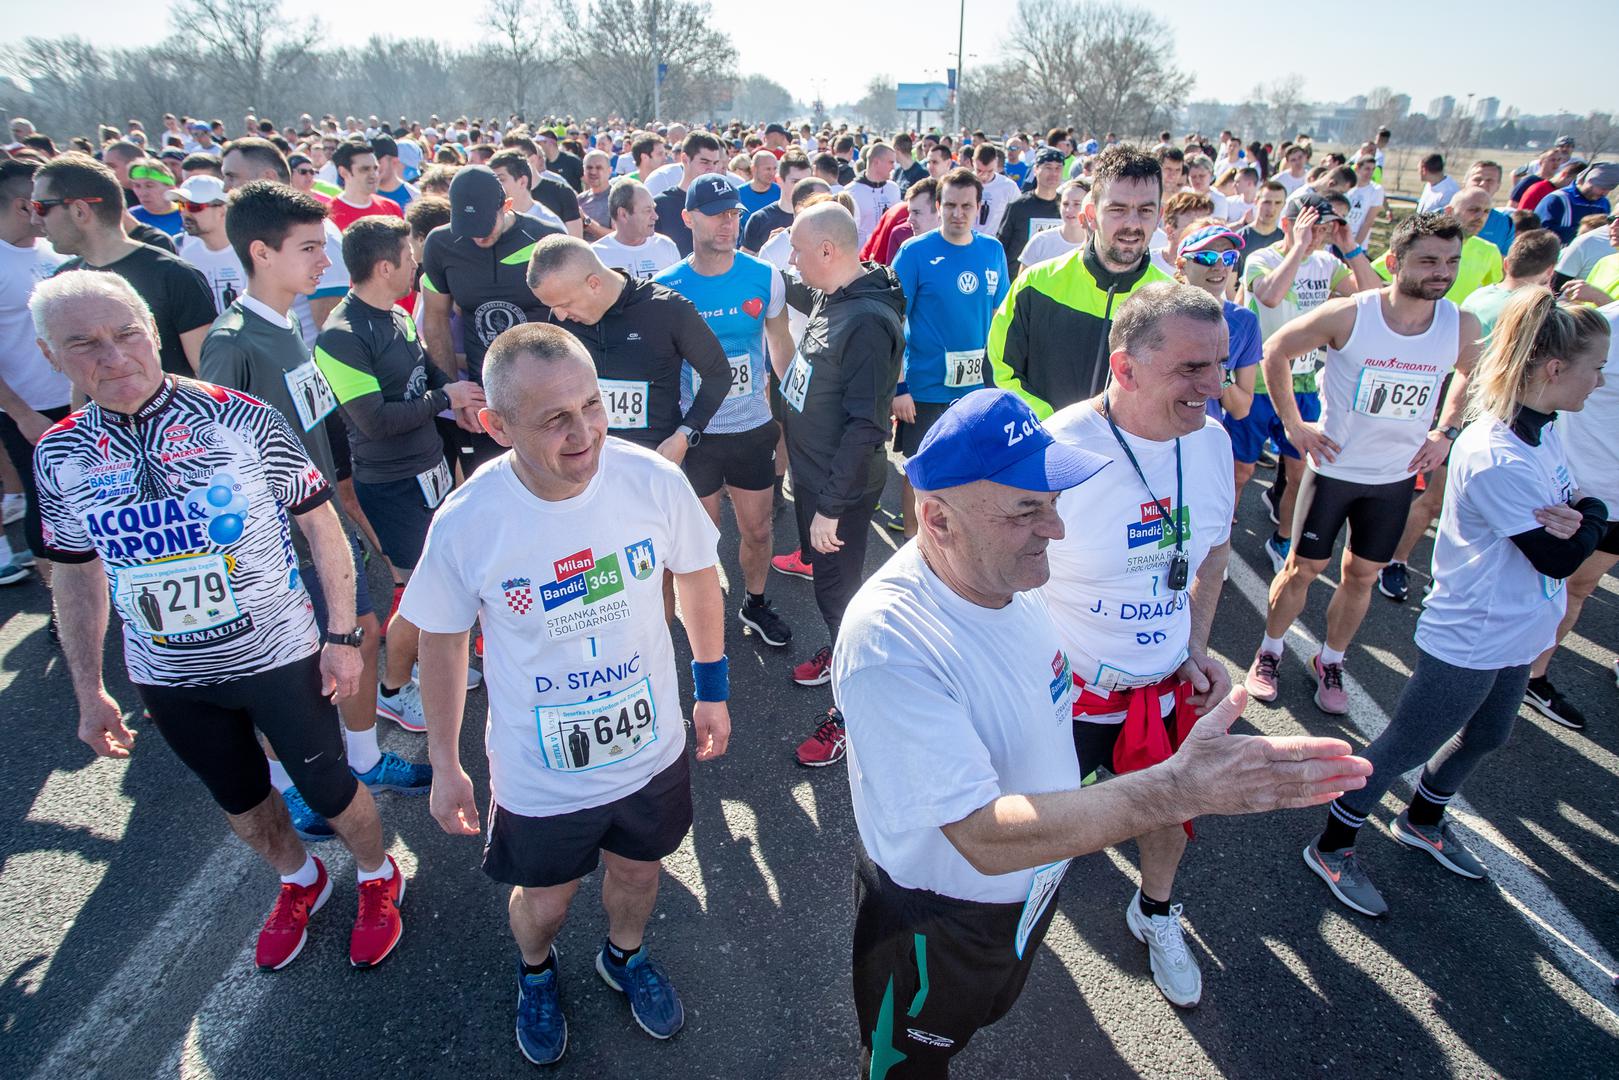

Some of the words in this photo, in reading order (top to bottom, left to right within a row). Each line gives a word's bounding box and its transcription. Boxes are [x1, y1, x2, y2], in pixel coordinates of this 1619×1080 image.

[712, 181, 732, 193] LA
[966, 358, 984, 375] 38
[1364, 358, 1387, 368] RUN
[1396, 362, 1437, 373] CROATIA
[608, 391, 643, 415] 148
[1390, 383, 1431, 407] 626
[171, 446, 207, 460] MERCURI
[89, 461, 133, 475] SPECIALIZED
[183, 465, 215, 482] Nalini
[89, 475, 117, 488] BASE
[86, 499, 186, 538] ACQUA
[187, 502, 209, 520] &
[1129, 525, 1162, 539] Bandić
[557, 558, 592, 574] Milan
[1127, 553, 1165, 566] STRANKA
[543, 580, 585, 602] Bandić
[589, 571, 618, 591] 365
[163, 572, 226, 612] 279
[546, 608, 597, 629] STRANKA
[600, 599, 628, 612] RADA
[1090, 599, 1108, 616] J.
[168, 617, 250, 643] RENAULT
[555, 608, 631, 637] SOLIDARNOSTI
[586, 637, 596, 657] 1
[535, 677, 559, 693] D.
[567, 650, 640, 690] STANIĆ
[593, 698, 651, 745] 649
